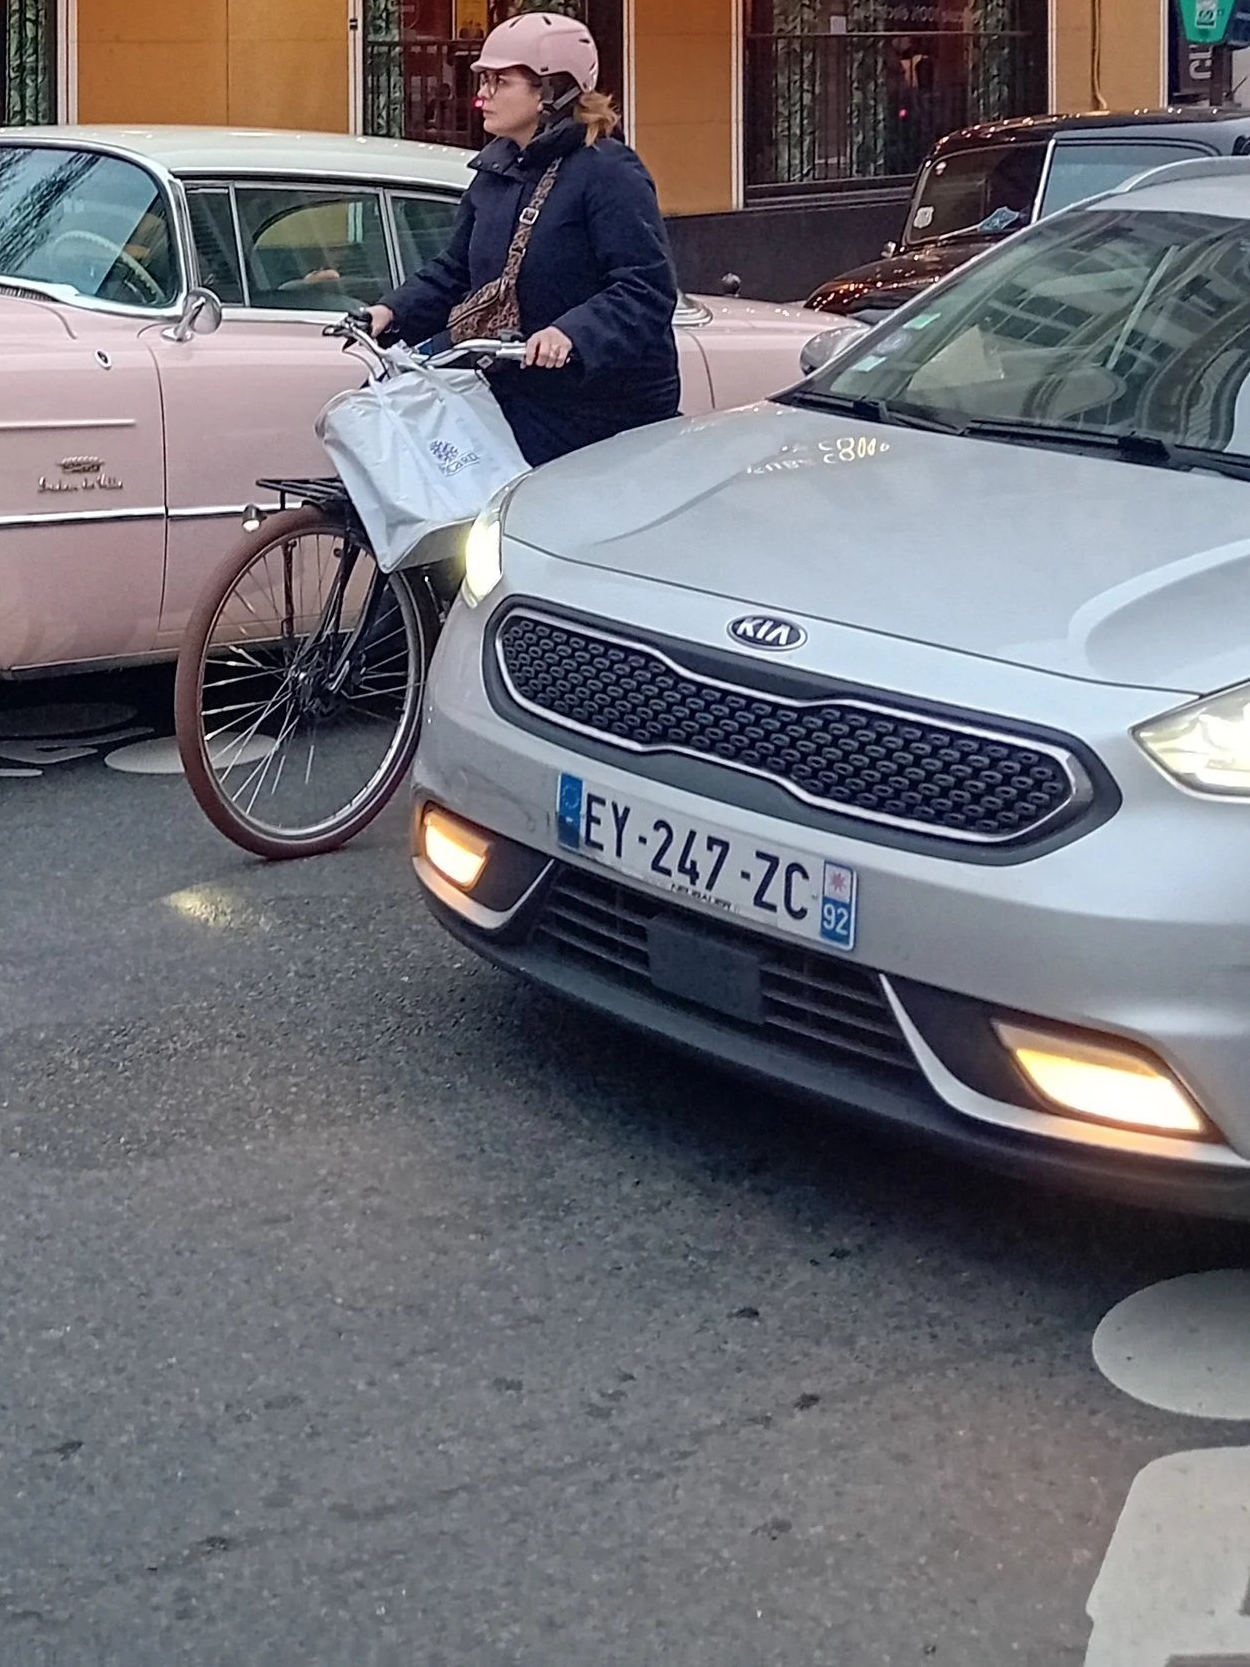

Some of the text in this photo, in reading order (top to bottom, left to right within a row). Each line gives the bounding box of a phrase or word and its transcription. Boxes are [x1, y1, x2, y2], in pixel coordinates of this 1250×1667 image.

[736, 617, 791, 645] KIA
[584, 793, 810, 921] EY-247-ZC
[822, 902, 849, 935] 92
